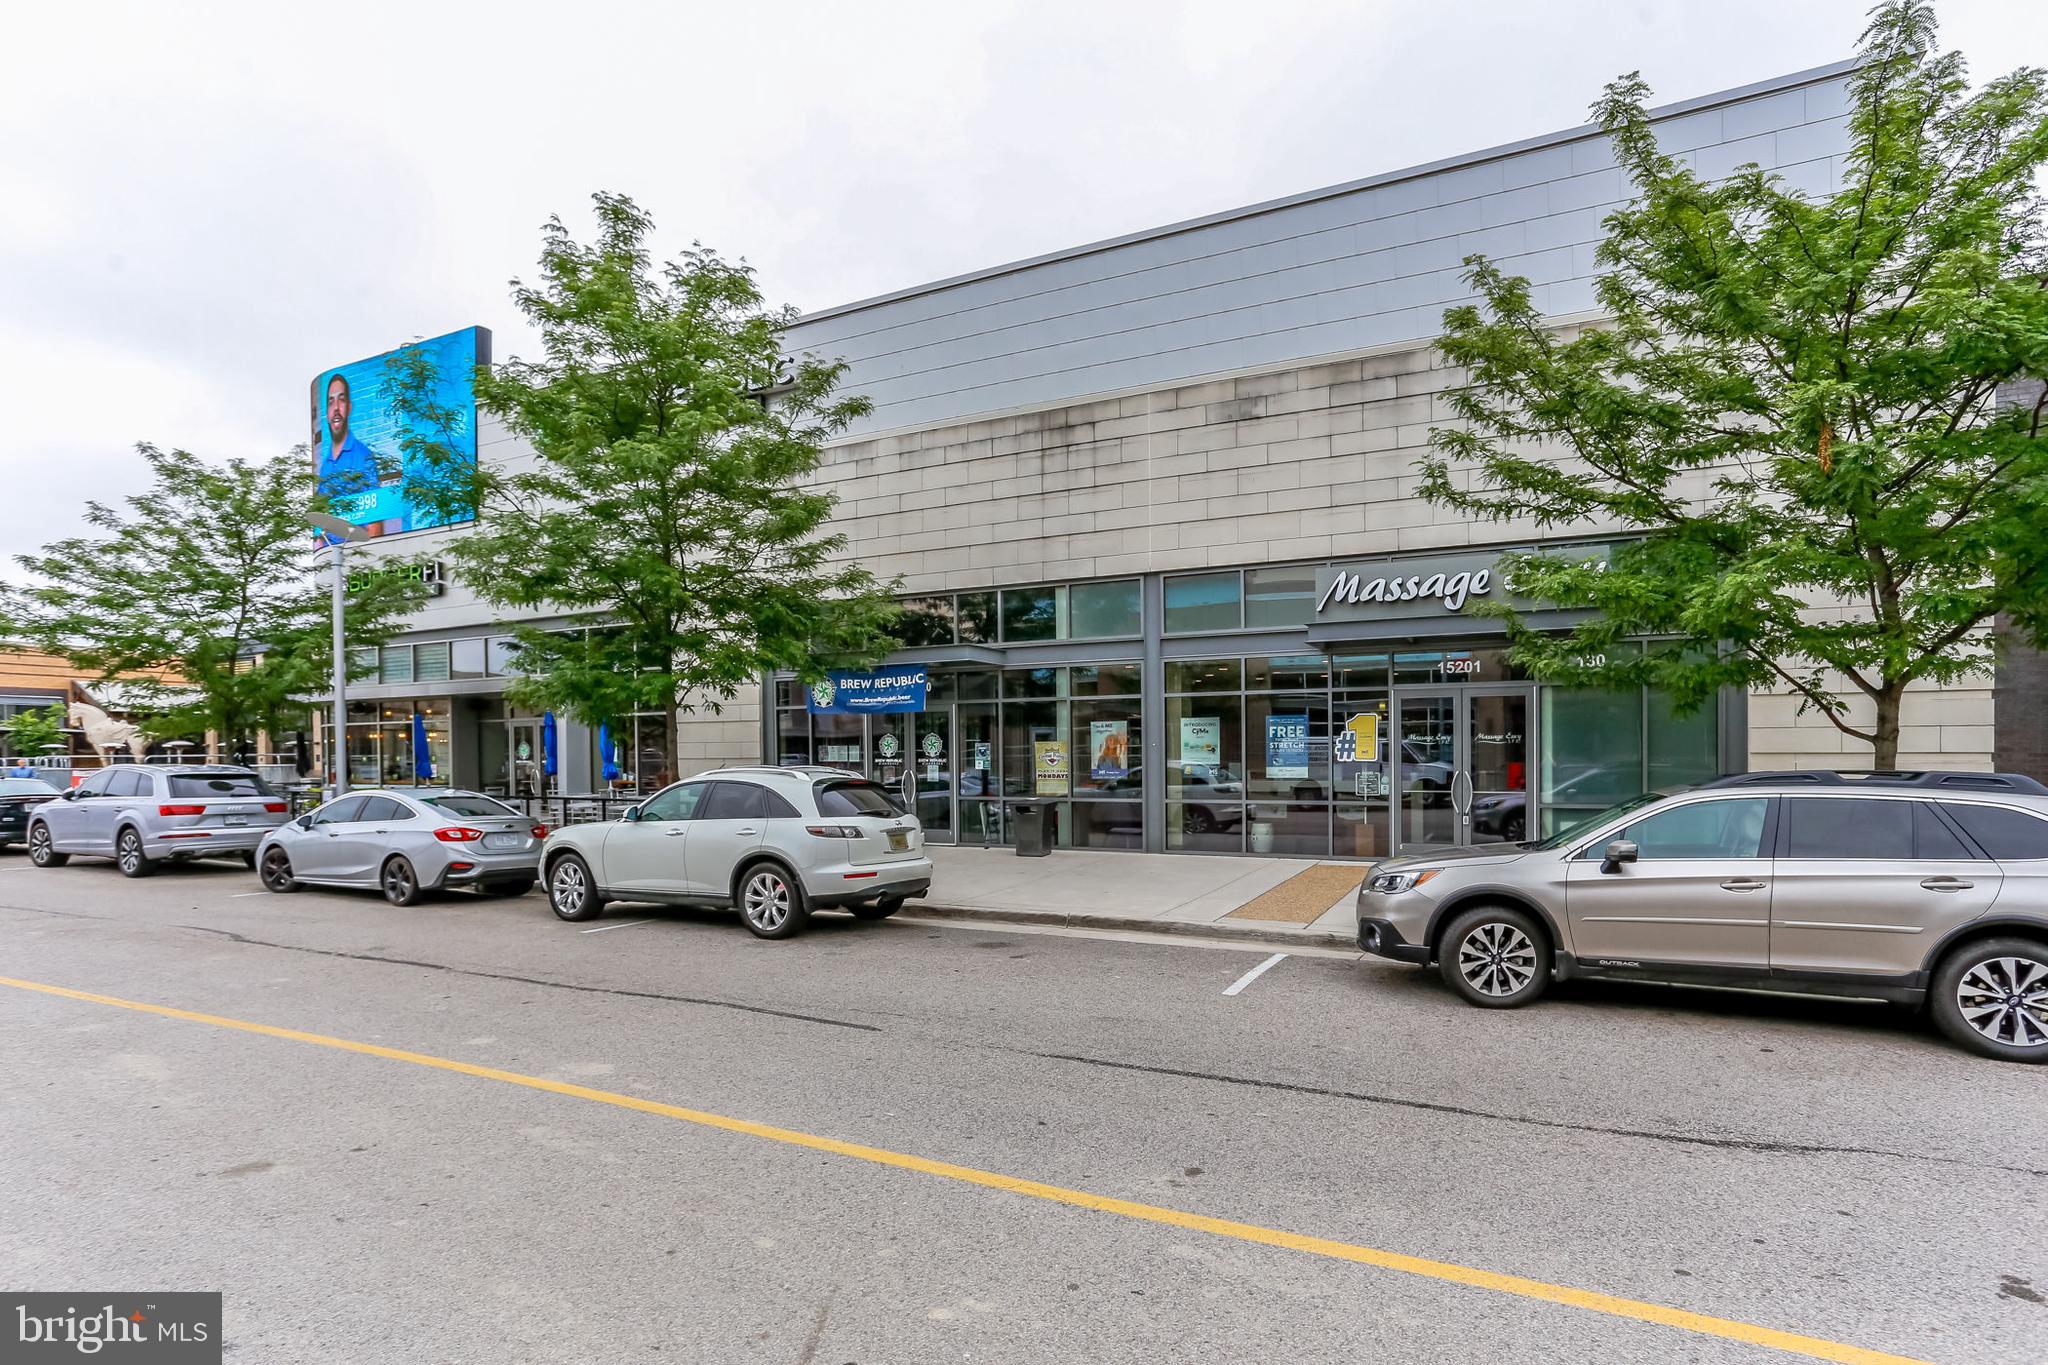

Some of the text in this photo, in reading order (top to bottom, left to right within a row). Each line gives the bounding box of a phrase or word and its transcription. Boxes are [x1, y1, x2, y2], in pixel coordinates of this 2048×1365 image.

[1316, 567, 1492, 613] Massage
[1437, 660, 1481, 674] 15201
[840, 673, 925, 689] BREW REPUBLIC
[1269, 725, 1305, 738] FREE
[1406, 733, 1434, 743] Massage
[1474, 732, 1504, 742] Massage
